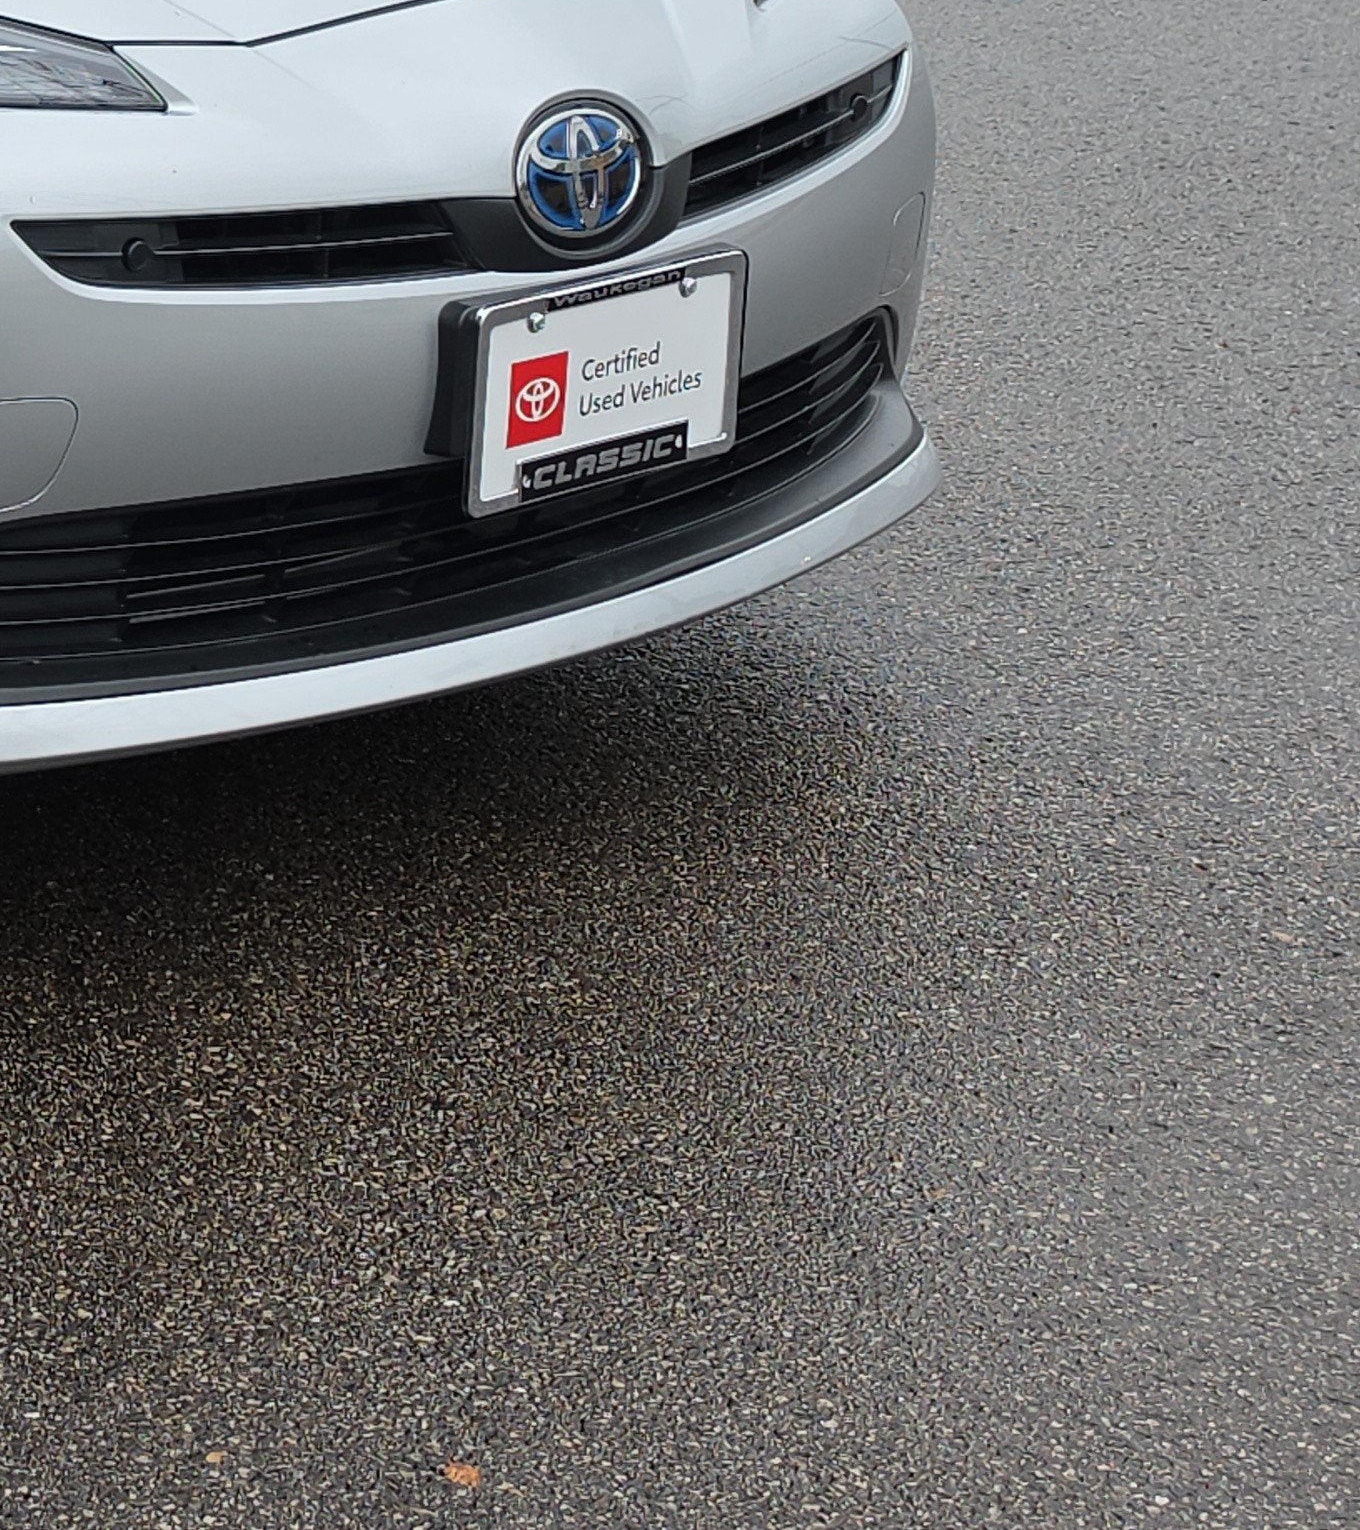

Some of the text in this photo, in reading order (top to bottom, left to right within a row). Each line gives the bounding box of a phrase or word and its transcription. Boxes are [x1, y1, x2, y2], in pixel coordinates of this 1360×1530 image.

[553, 269, 682, 309] Waukegan
[582, 341, 661, 381] Certified
[579, 369, 702, 418] Used Vehicles
[532, 433, 674, 491] CLASSIC
